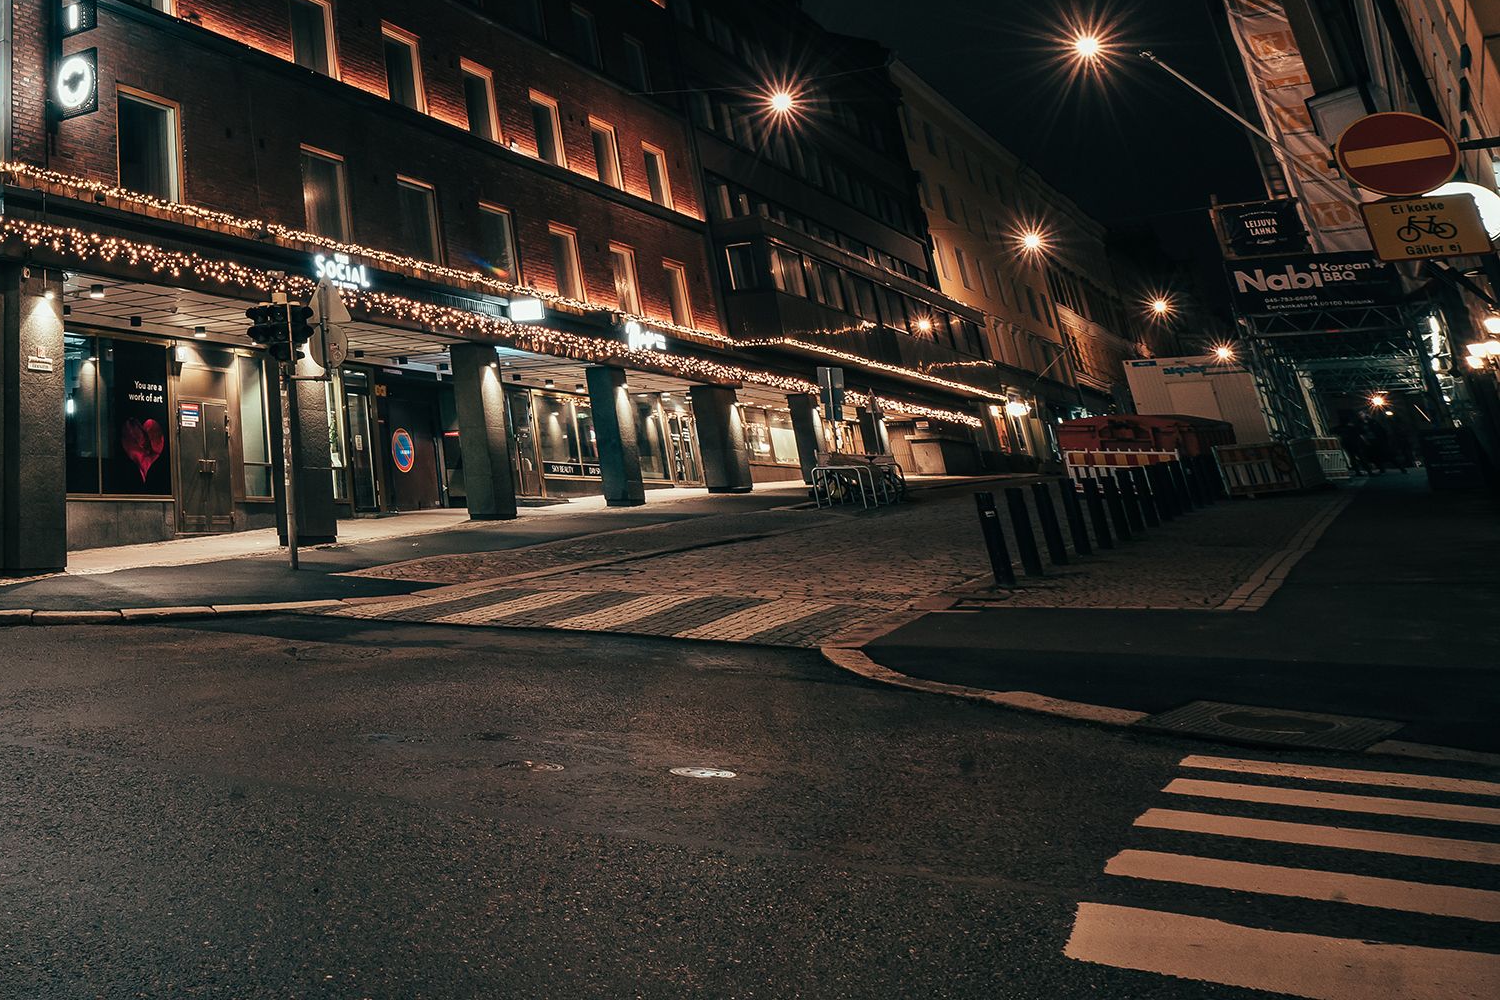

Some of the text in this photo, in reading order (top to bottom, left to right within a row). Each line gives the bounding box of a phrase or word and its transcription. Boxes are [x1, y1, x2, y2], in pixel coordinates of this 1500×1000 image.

[1391, 201, 1445, 215] Ei koske
[1244, 218, 1278, 229] LEIJUVA
[1250, 227, 1278, 236] LAHNA
[1405, 242, 1462, 255] Gäller ej
[315, 254, 370, 287] SOCIAL
[1319, 261, 1371, 272] Korean
[1233, 263, 1324, 293] Nabi
[1322, 271, 1357, 282] BBQ
[134, 380, 146, 390] You
[128, 392, 163, 403] work of art
